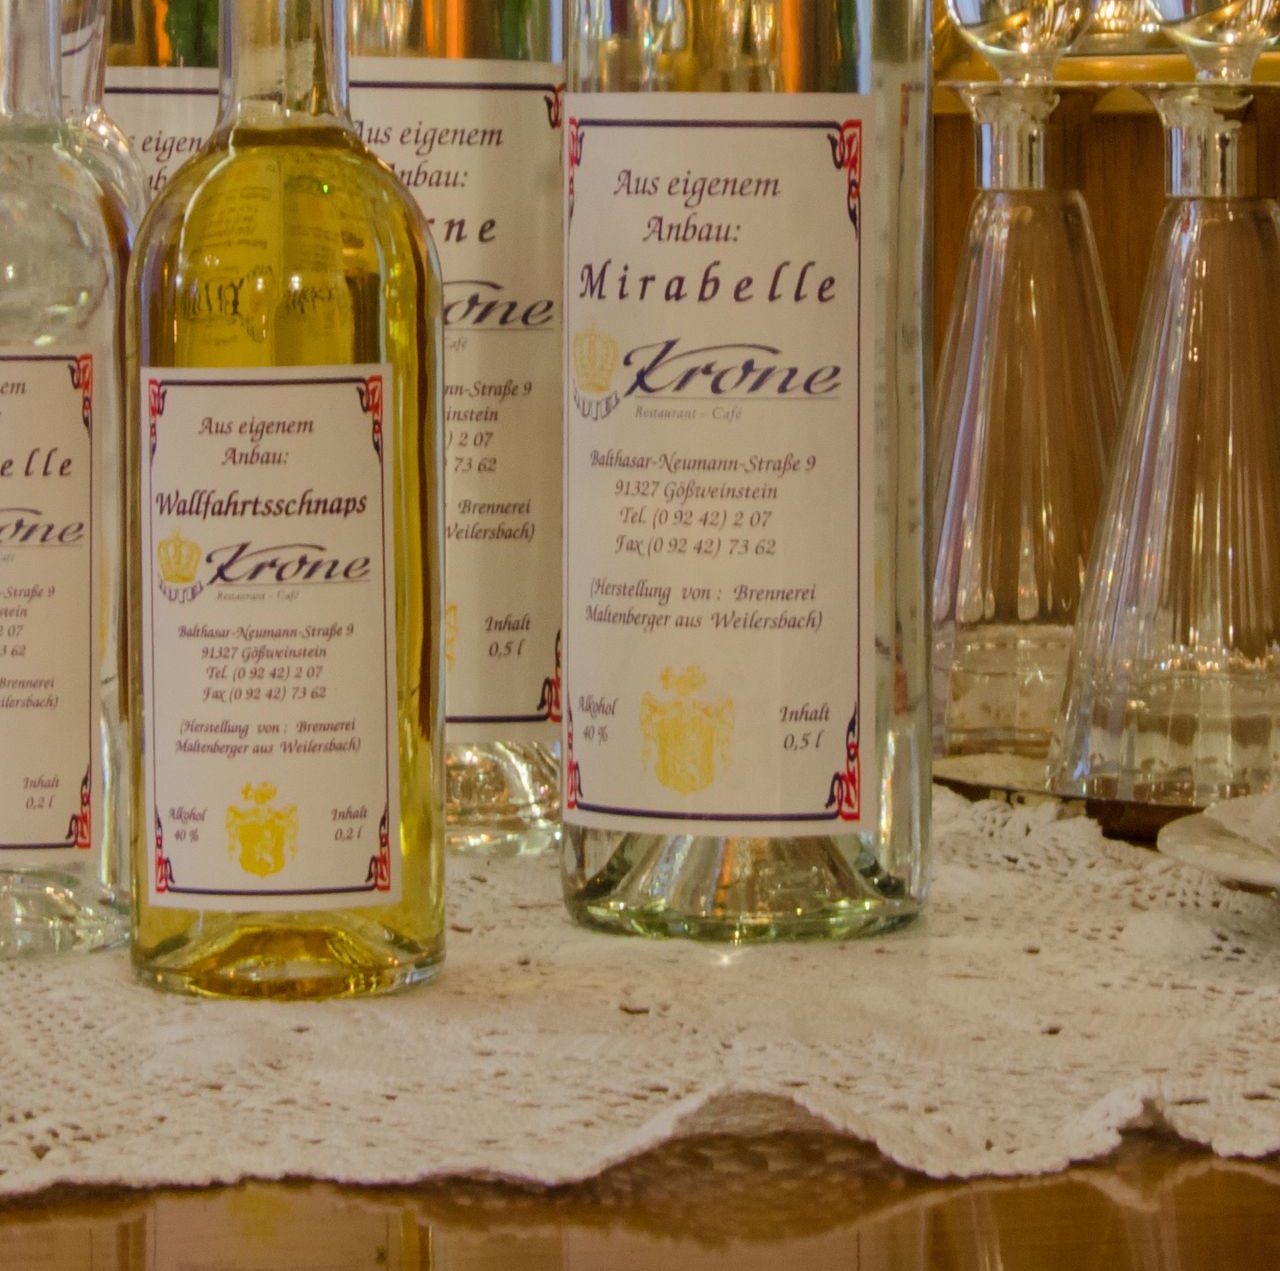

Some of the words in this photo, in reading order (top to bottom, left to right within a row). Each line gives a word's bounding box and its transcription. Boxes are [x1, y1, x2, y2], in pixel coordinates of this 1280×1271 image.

[141, 129, 202, 163] eigen
[399, 120, 504, 157] eigenem
[388, 159, 468, 191] nbau:
[613, 168, 661, 197] Aus
[666, 169, 781, 209] eigenem
[642, 212, 741, 243] Anbau:
[579, 258, 836, 304] Mirabelle
[444, 280, 555, 326] one
[622, 337, 842, 397] Krone
[198, 416, 233, 436] Aus
[237, 416, 314, 444] eigenem
[221, 443, 289, 466] Anbau:
[155, 488, 368, 521] Wallfahrtsschnaps
[614, 479, 661, 498] 91327
[663, 479, 778, 506] Gößweinstein
[619, 505, 647, 525] Tel.
[652, 508, 669, 530] (0
[672, 509, 694, 527] 92
[698, 509, 728, 529] 42)
[732, 510, 745, 528] 2
[749, 510, 773, 528] 07
[614, 534, 644, 557] Fax
[647, 536, 664, 558] (0
[667, 537, 688, 555] 92
[692, 537, 722, 557] 42)
[728, 538, 750, 556] 73
[754, 538, 777, 556] 62
[205, 541, 371, 586] Krone
[681, 586, 711, 601] von
[733, 583, 816, 602] Brennerei
[484, 613, 531, 633] Inhalt
[585, 603, 672, 633] Maltenberger
[674, 615, 703, 629] aus
[710, 609, 823, 632] Weilersbach)
[488, 640, 514, 659] 0,5
[205, 665, 228, 680] Tel.
[268, 665, 291, 681] 42)
[202, 686, 226, 703] Fax
[264, 686, 287, 702] 42)
[578, 694, 619, 719] Alkohol
[779, 702, 830, 723] Inhalt
[783, 732, 811, 752] 0,5
[23, 775, 60, 790] Inhalt
[25, 796, 46, 810] 0,2
[168, 806, 207, 825] Alkohol
[331, 805, 368, 822] Inhalt
[333, 827, 354, 842] 0,2
